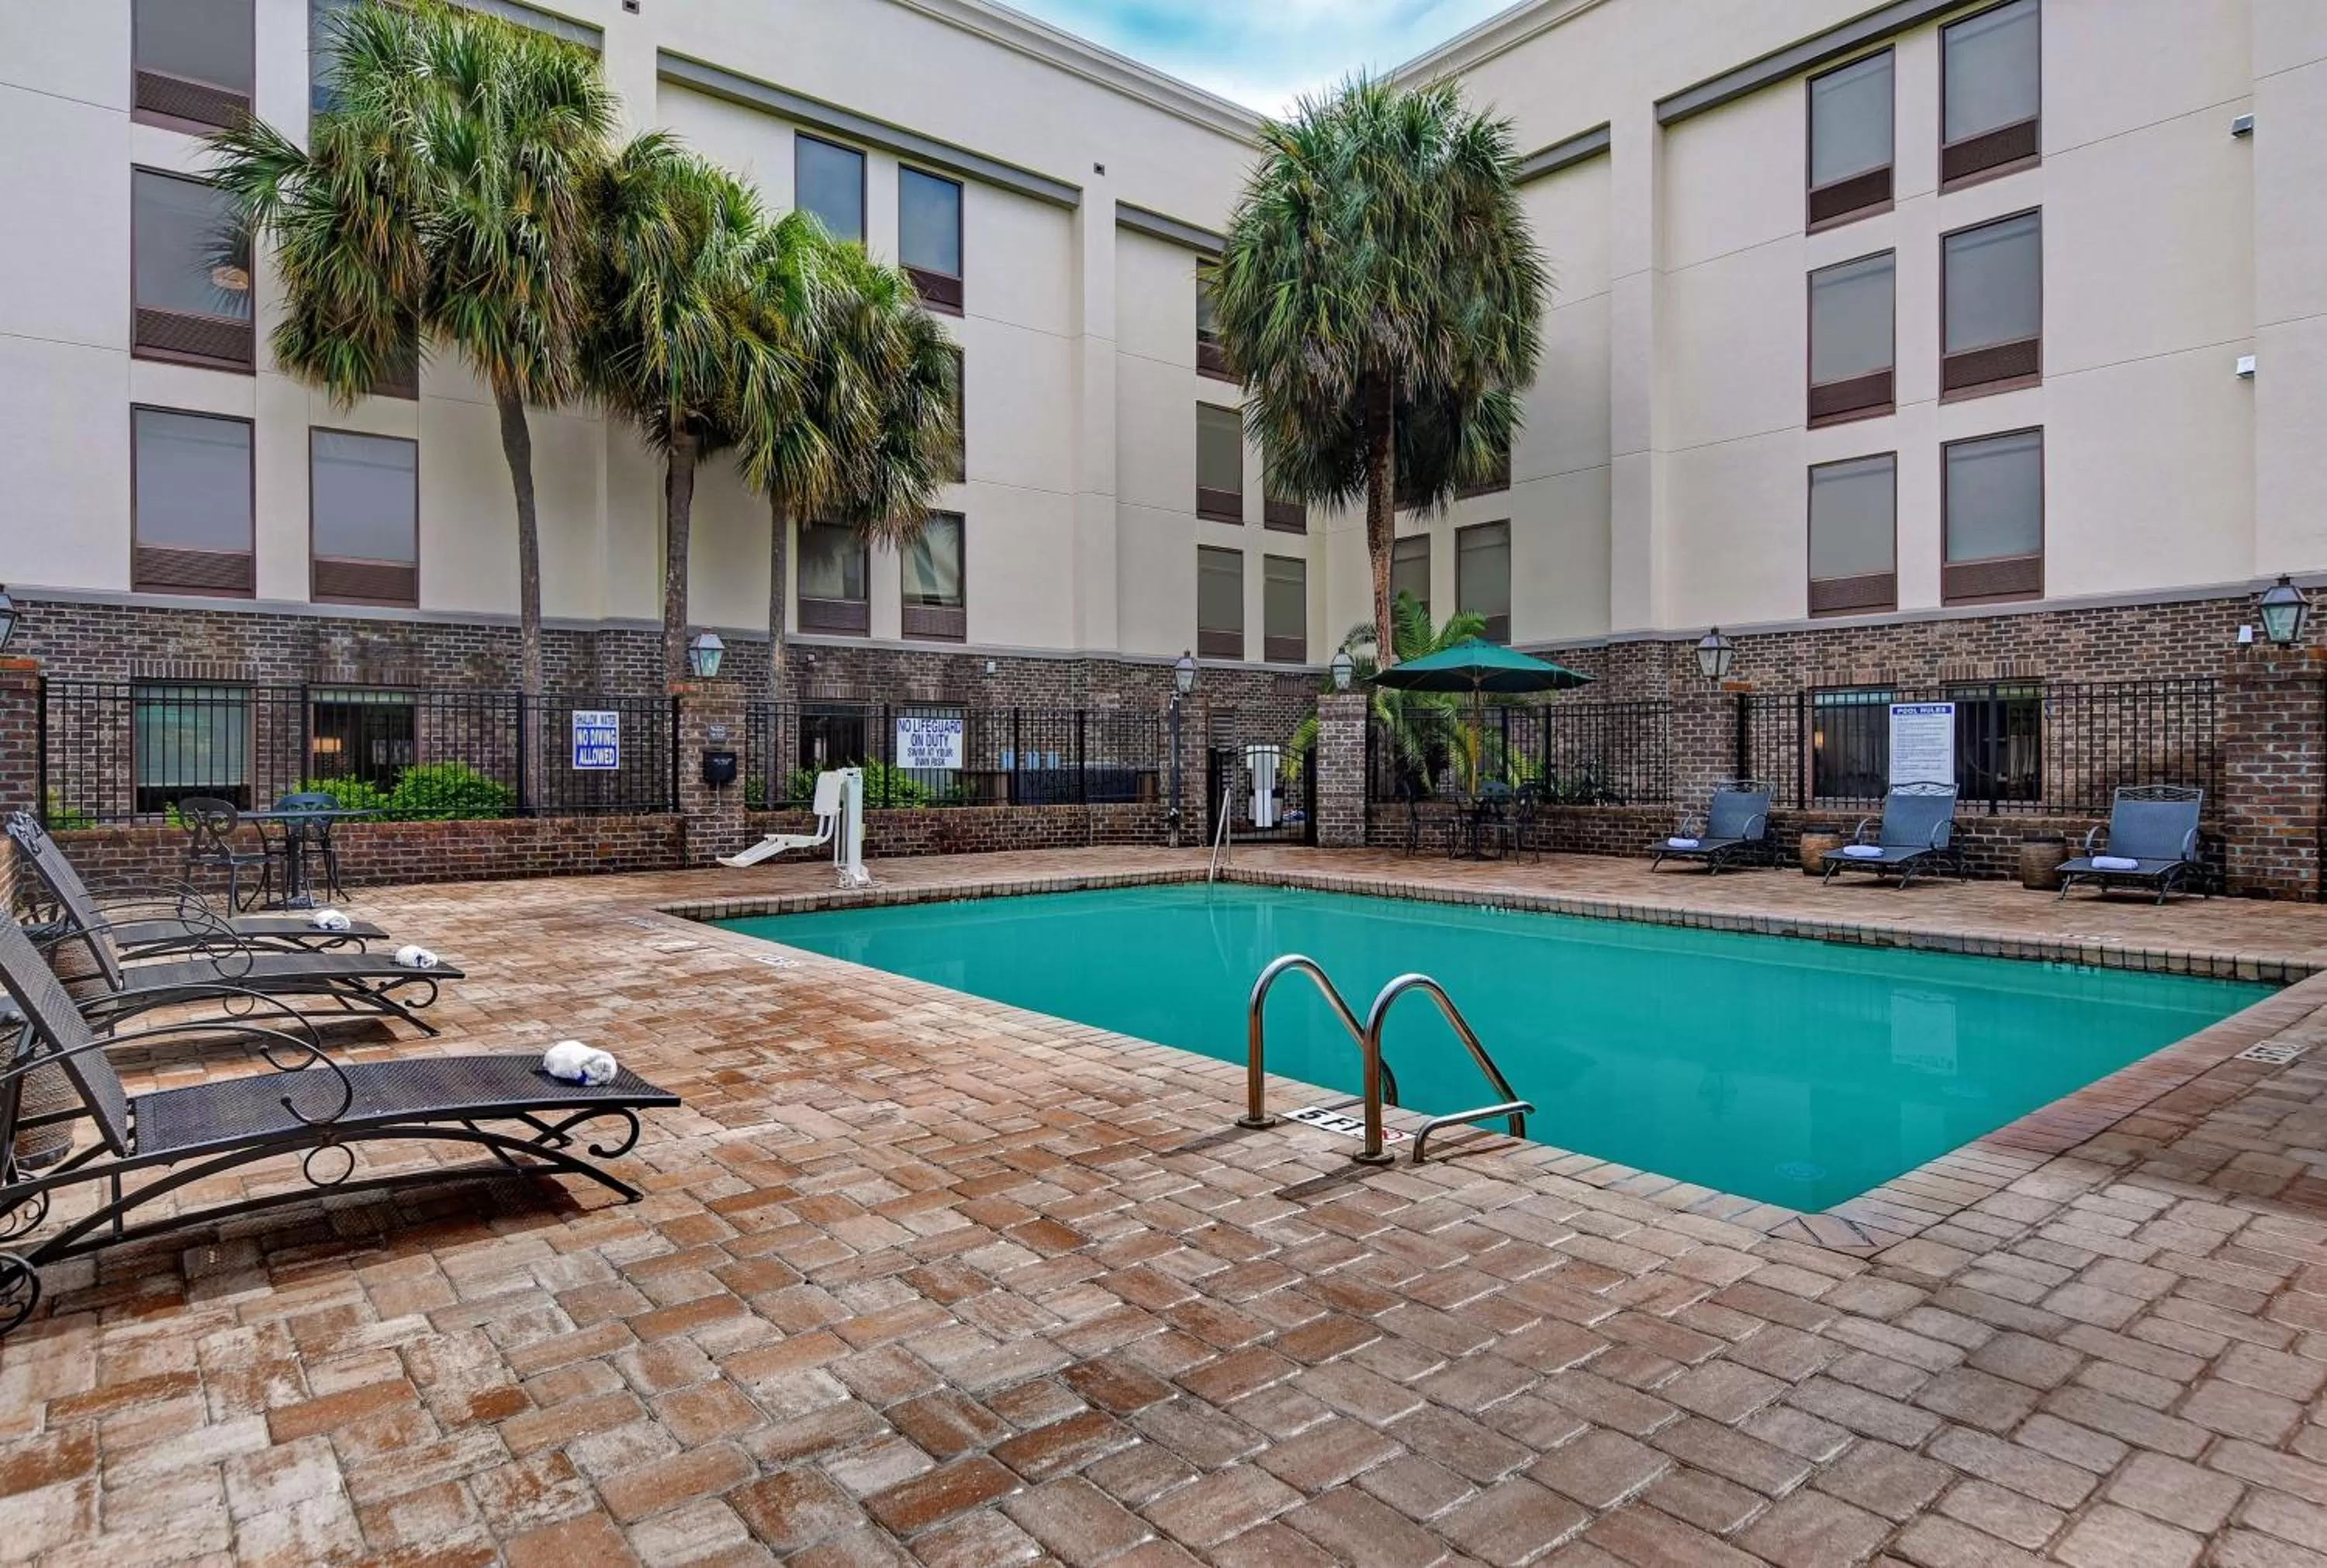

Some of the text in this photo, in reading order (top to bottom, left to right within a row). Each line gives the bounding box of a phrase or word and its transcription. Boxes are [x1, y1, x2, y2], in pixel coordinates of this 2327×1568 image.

[897, 719, 962, 734] NO LIFEGUARD
[576, 728, 617, 746] NO DIVING
[911, 733, 949, 747] ON DUTY
[578, 747, 616, 766] ALLOWED
[907, 747, 926, 758] SWIM
[936, 748, 953, 758] YOUR
[1297, 1109, 1329, 1121] 5
